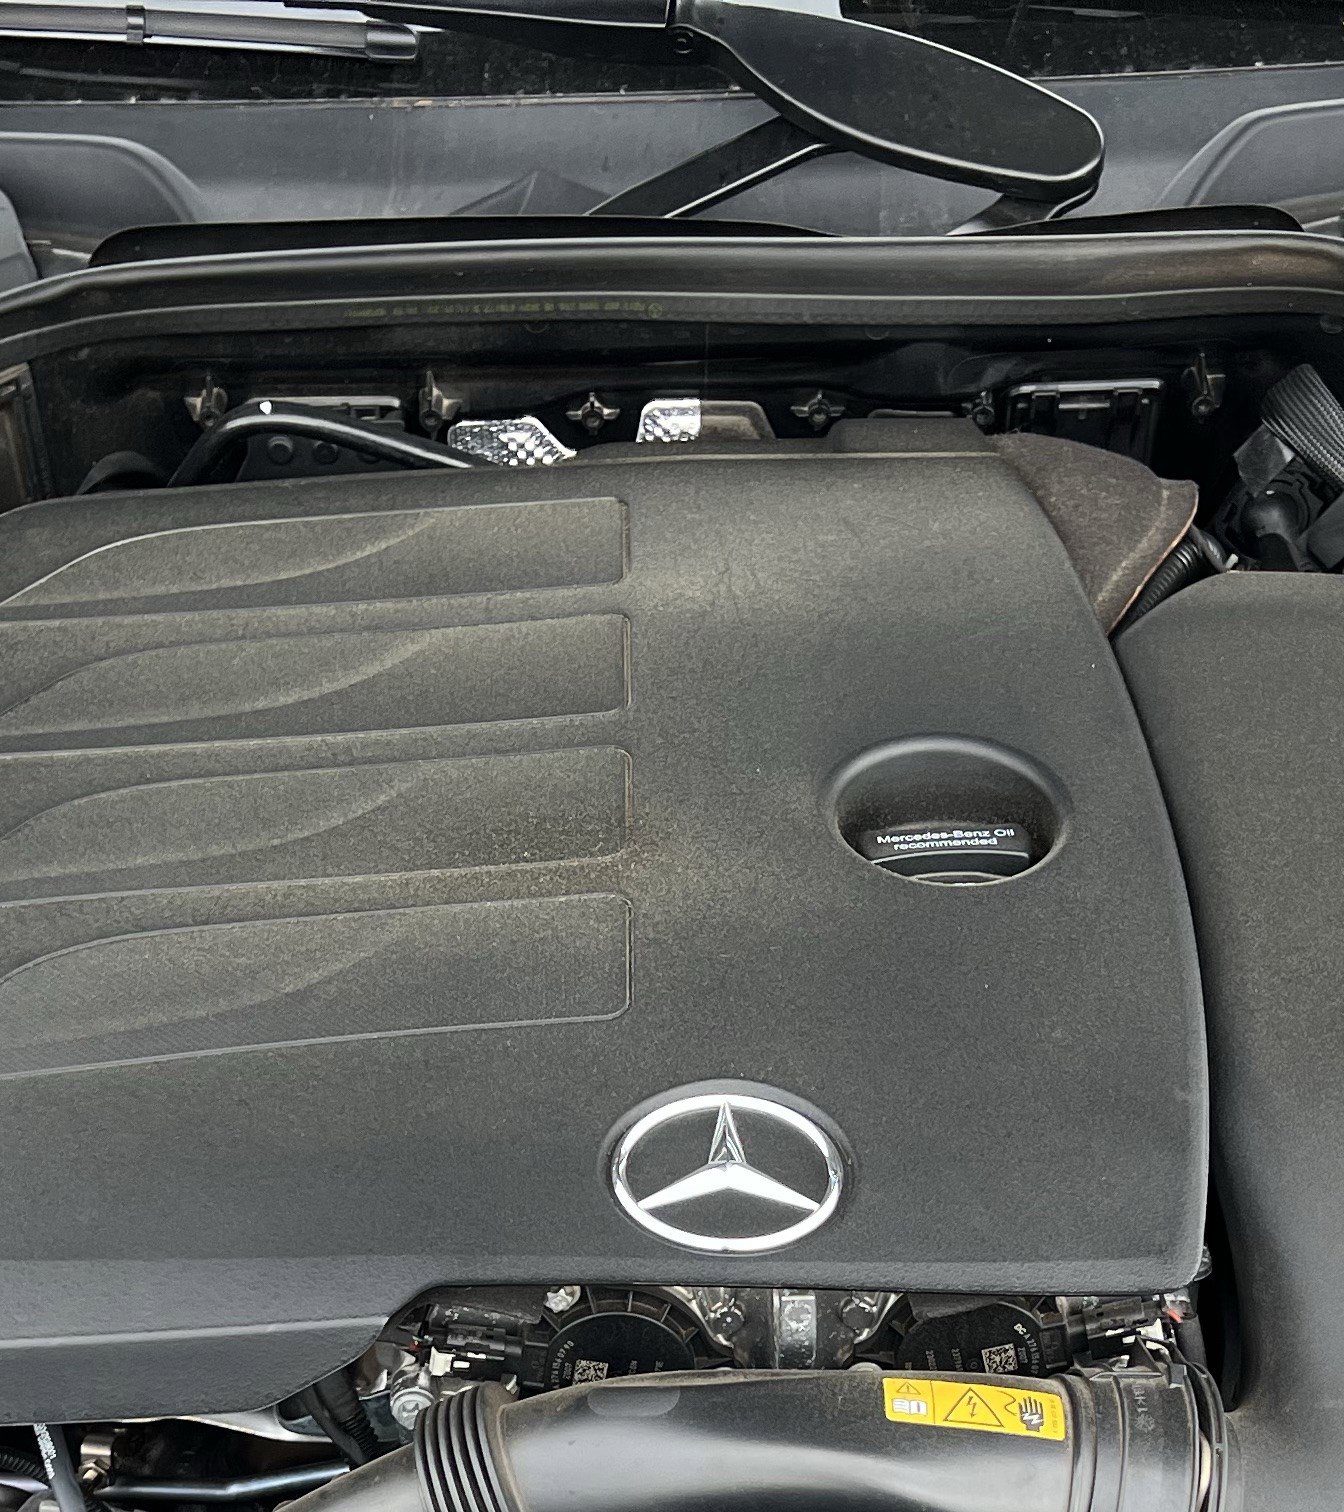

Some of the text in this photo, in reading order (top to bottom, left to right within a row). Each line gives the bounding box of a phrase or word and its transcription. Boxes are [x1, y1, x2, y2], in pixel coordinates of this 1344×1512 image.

[876, 828, 1015, 844] Mercedes-Benz Oil
[893, 837, 998, 850] recommended
